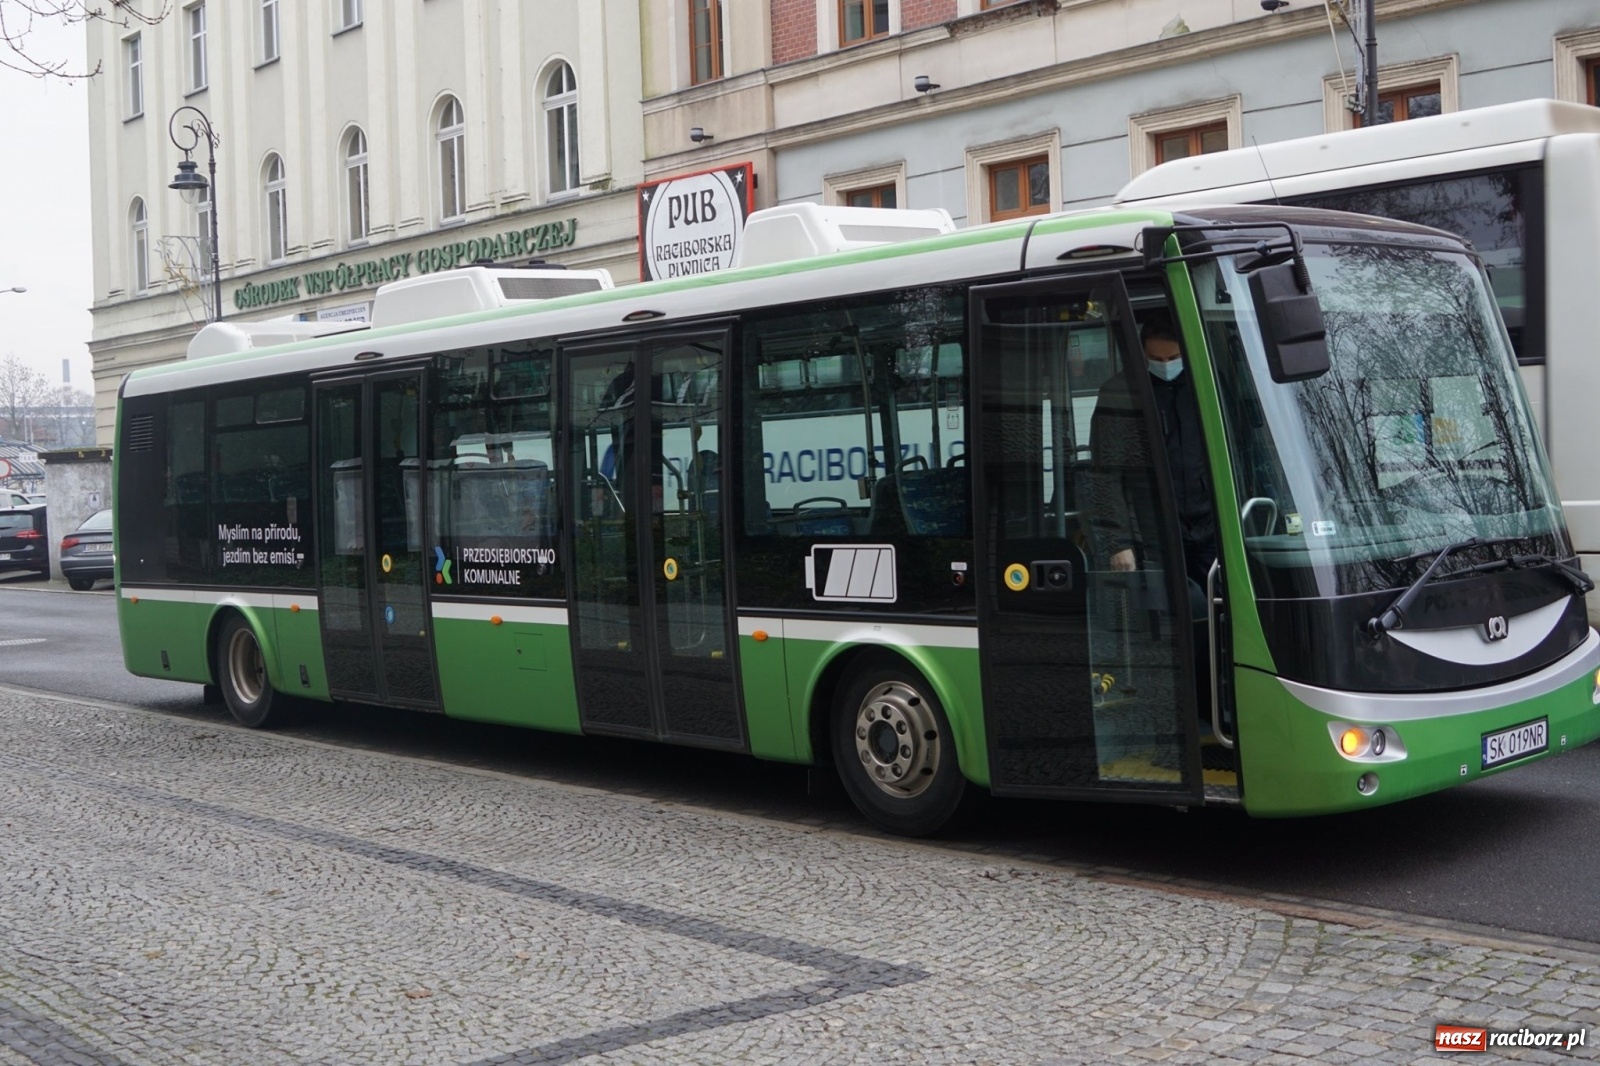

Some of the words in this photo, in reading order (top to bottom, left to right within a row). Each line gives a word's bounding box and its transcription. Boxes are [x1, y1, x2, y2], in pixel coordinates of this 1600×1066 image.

[668, 188, 717, 229] PUB
[233, 277, 299, 310] OŚRODEK
[303, 253, 411, 296] WSPÓŁPRACY
[415, 218, 577, 274] GOSPODARCZEJ
[218, 524, 249, 543] Myslím
[252, 527, 262, 540] na
[265, 523, 300, 542] přírodu,
[223, 547, 250, 567] jezdím
[253, 547, 268, 564] bez
[270, 547, 297, 564] emisí.
[463, 547, 555, 567] PRZEDSIĘBIORSTWO
[464, 569, 520, 585] KOMUNALNE
[1490, 735, 1505, 760] SK
[1509, 724, 1544, 754] 019NR
